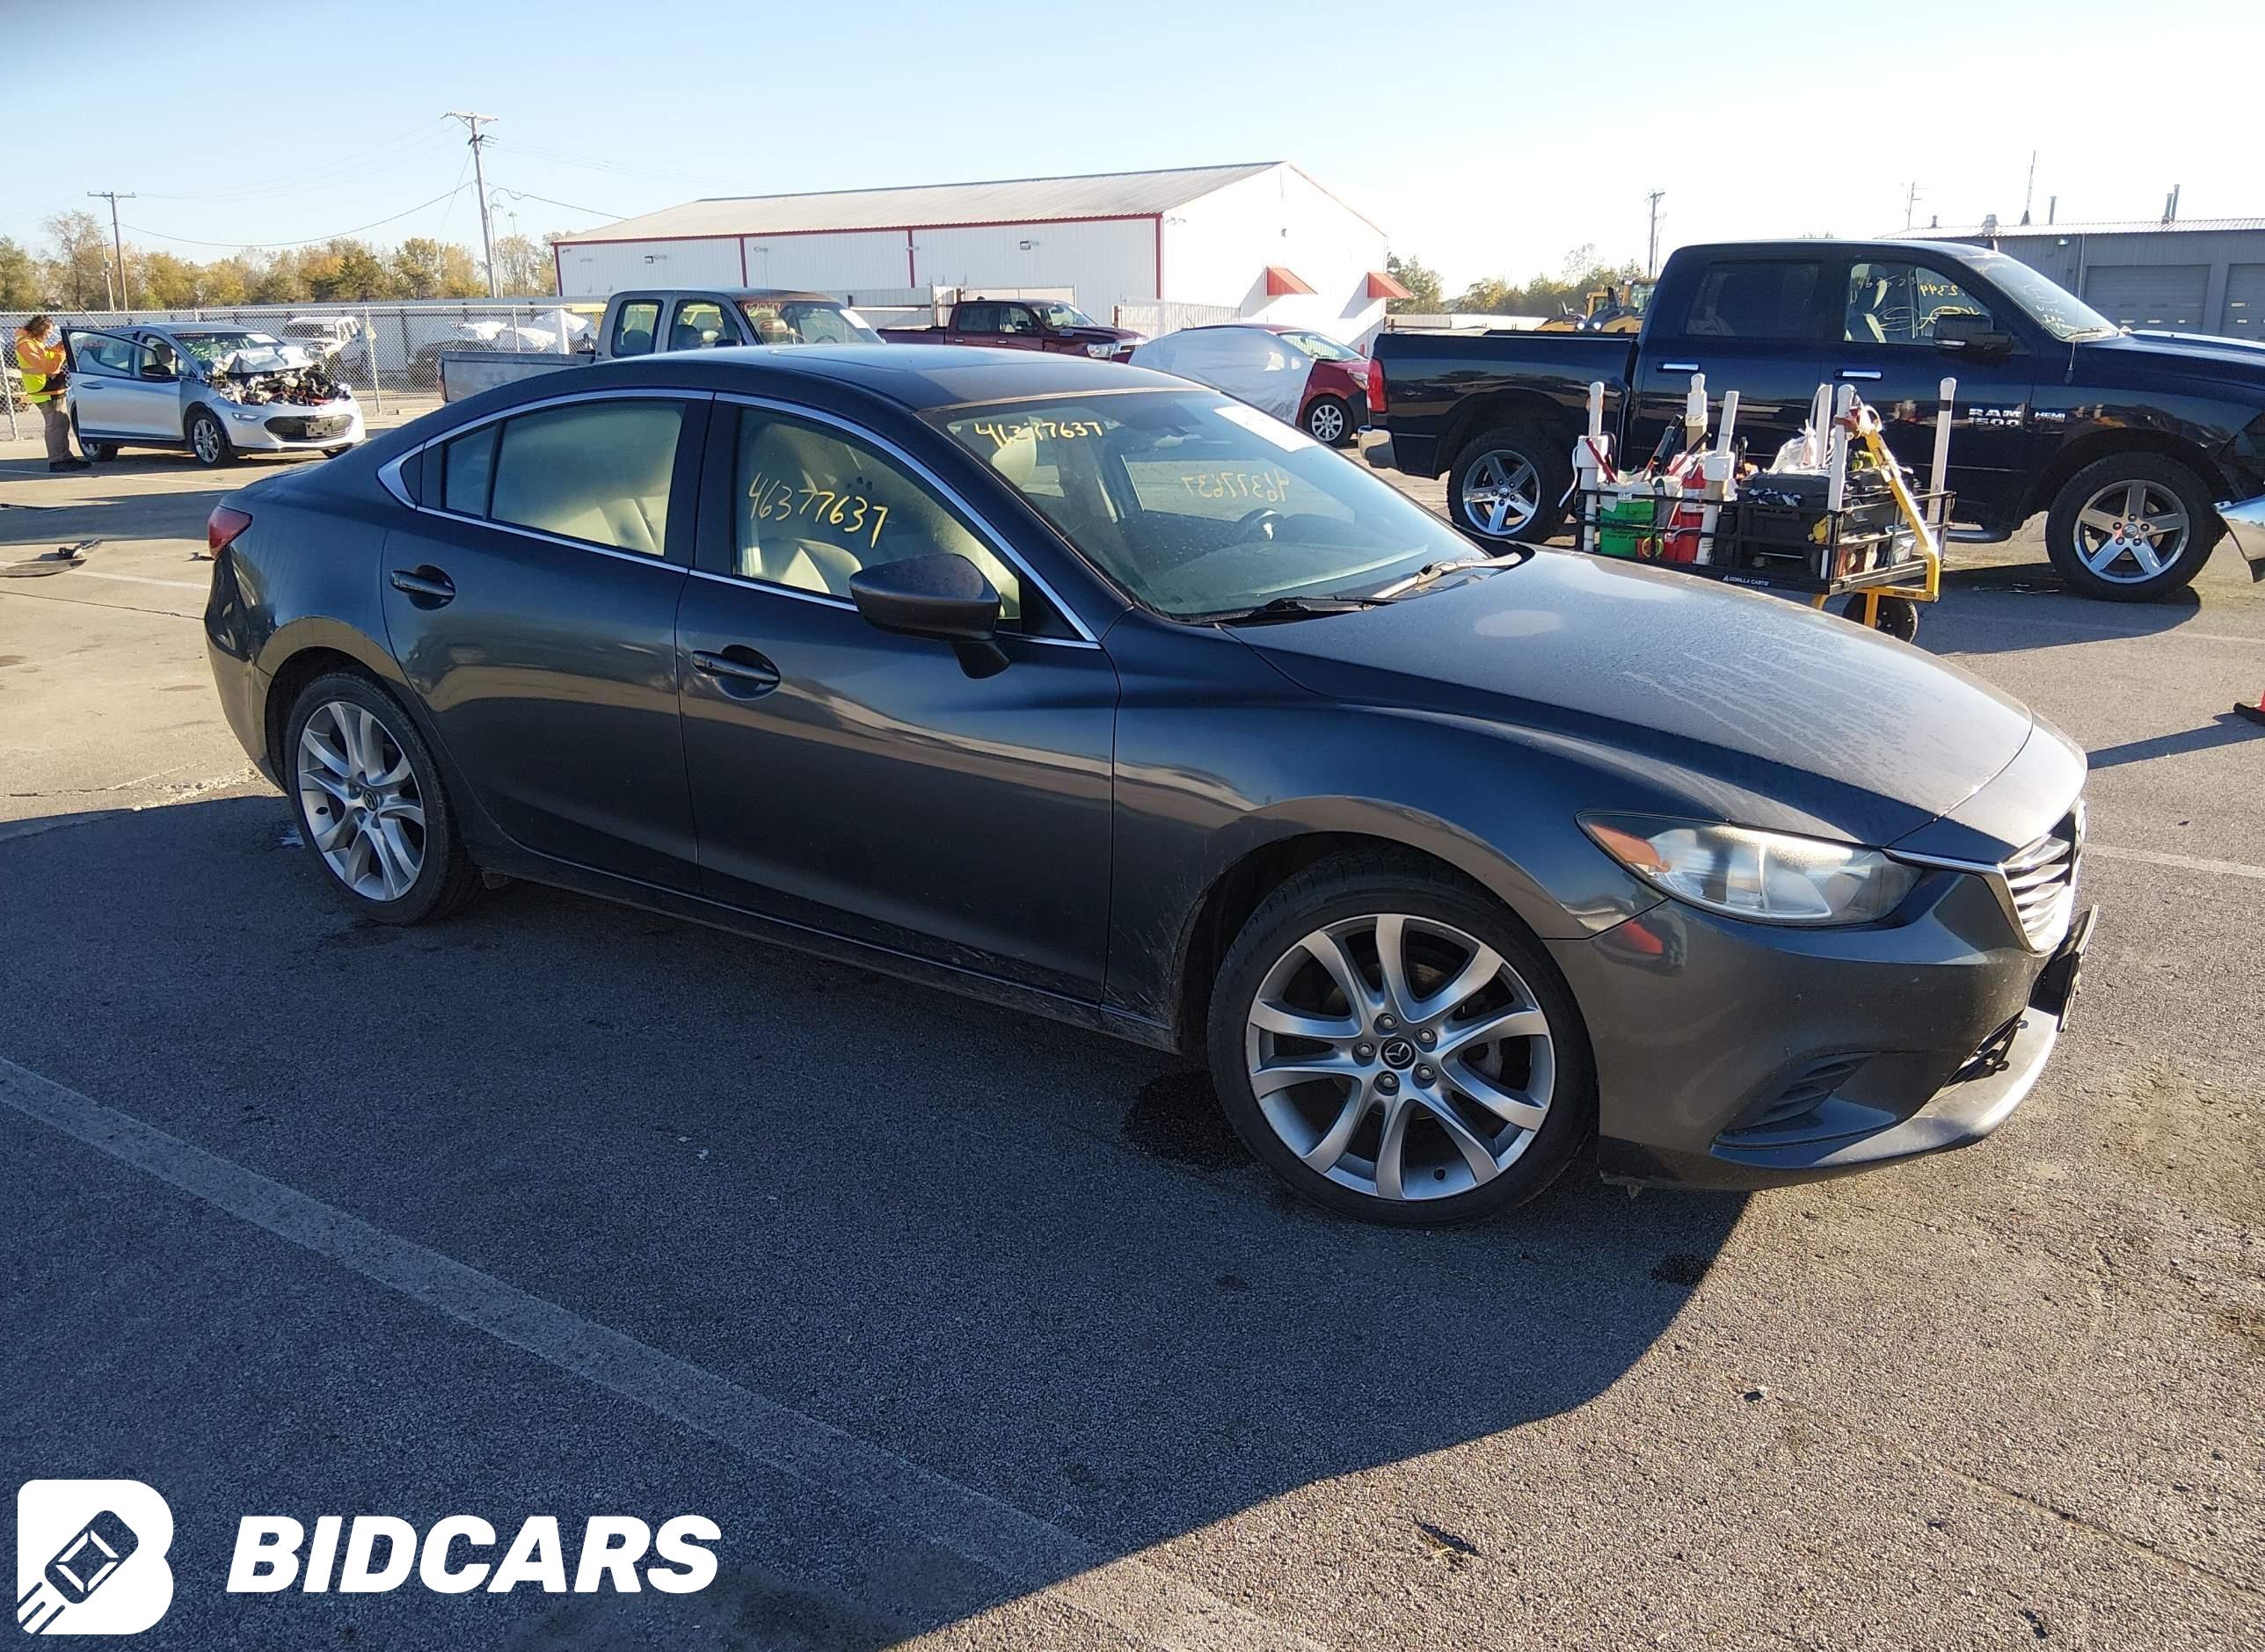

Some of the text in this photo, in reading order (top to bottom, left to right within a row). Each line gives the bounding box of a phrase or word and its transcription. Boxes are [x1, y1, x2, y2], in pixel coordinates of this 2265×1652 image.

[1969, 408, 2022, 418] RAM
[1969, 417, 2021, 427] 1500
[747, 471, 889, 549] 46377637
